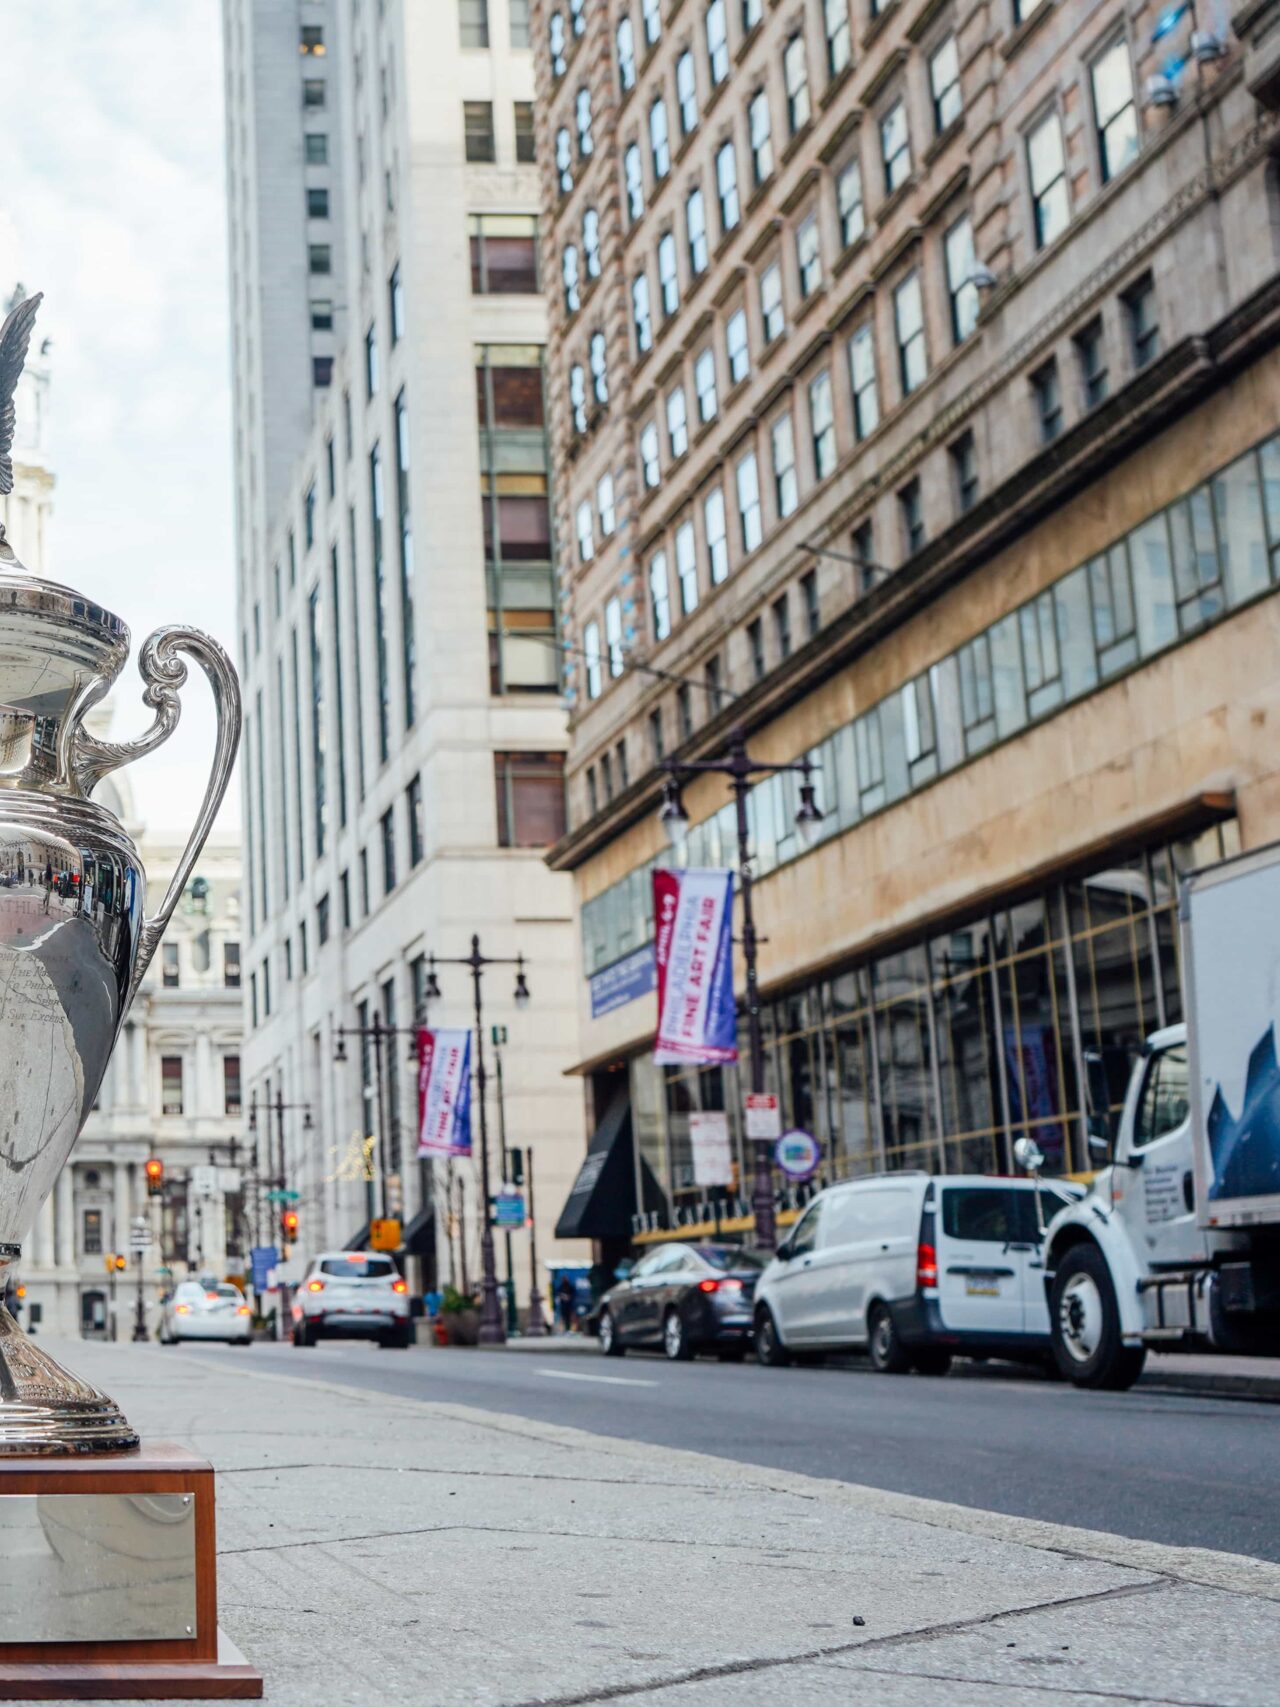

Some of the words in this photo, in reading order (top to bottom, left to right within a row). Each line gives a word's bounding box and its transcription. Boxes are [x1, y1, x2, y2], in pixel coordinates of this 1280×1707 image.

[697, 898, 715, 942] FAIR
[666, 896, 699, 1036] PHILADELPHIA
[690, 948, 706, 987] ART
[682, 994, 699, 1037] FINE
